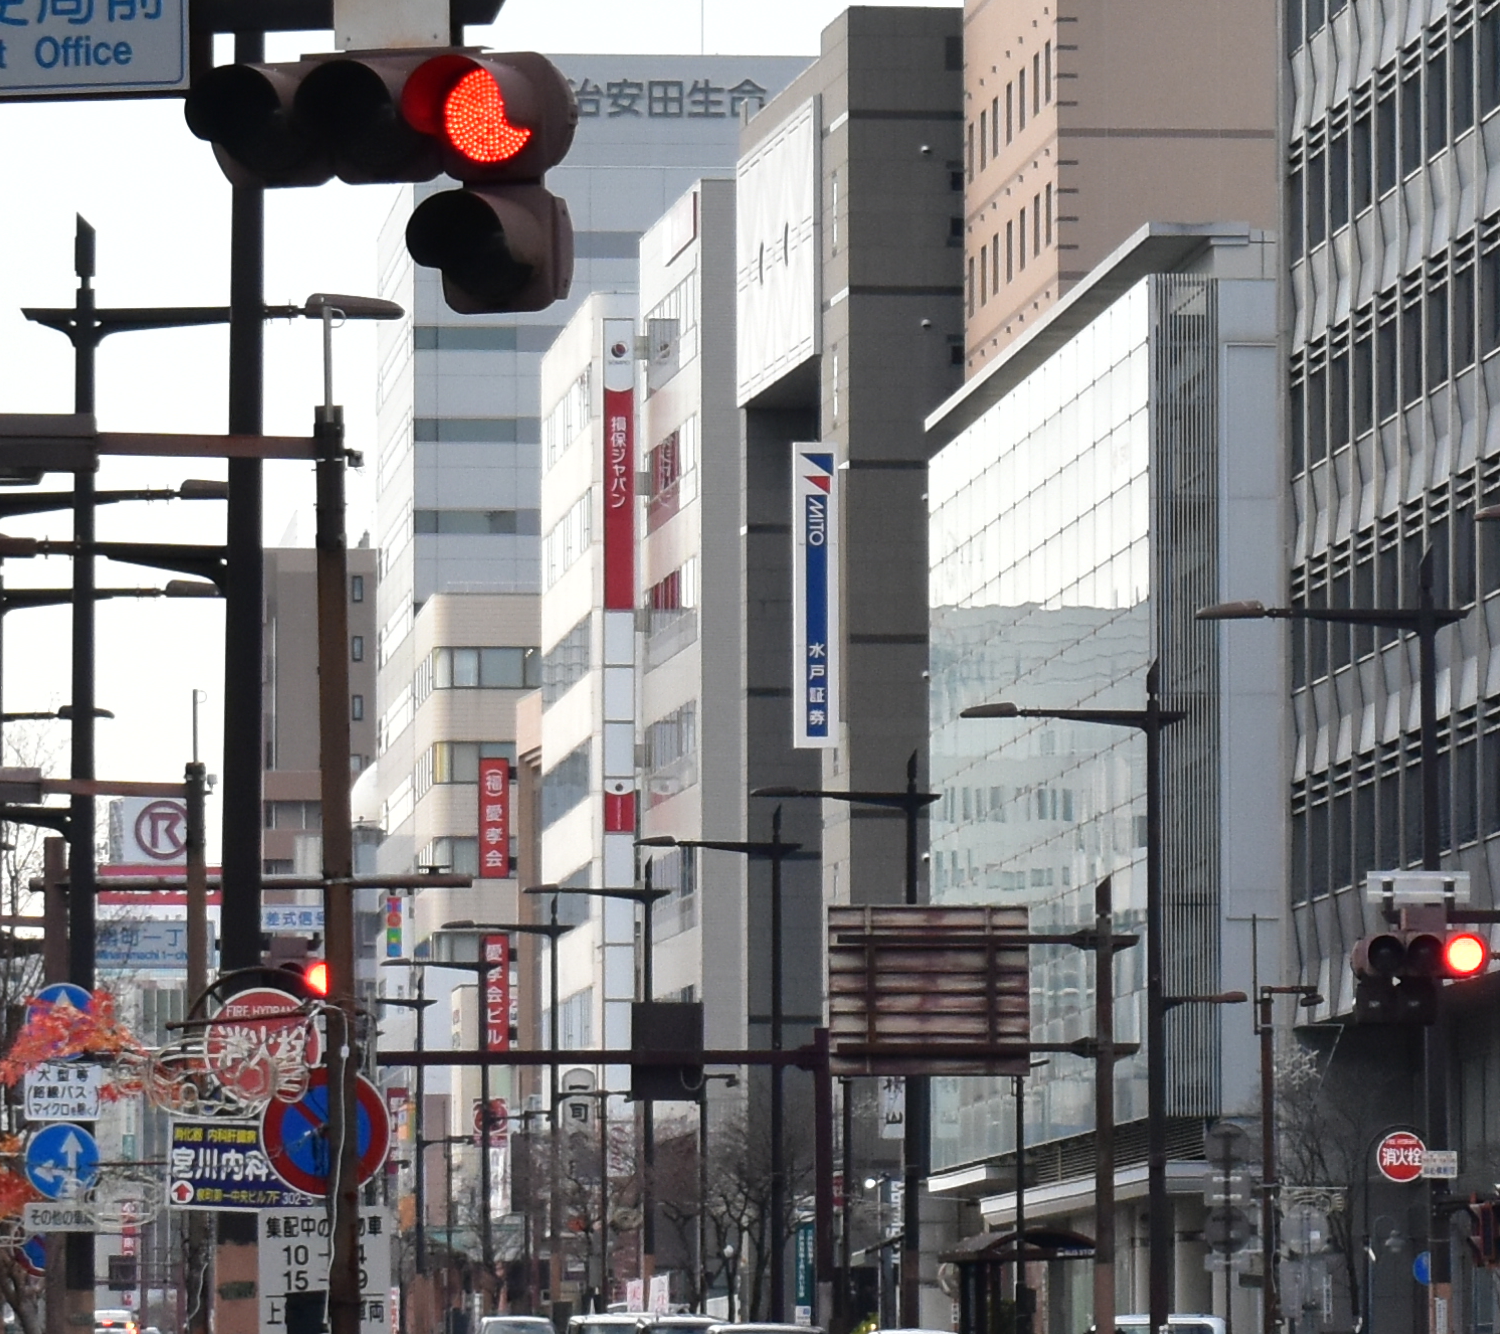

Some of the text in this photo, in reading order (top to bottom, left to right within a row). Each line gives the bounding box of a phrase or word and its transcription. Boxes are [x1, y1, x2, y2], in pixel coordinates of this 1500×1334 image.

[35, 35, 132, 69] Office
[610, 416, 627, 509] 損保ジャパン
[809, 496, 825, 546] MITO
[808, 641, 826, 728] 水戸証券
[265, 911, 325, 927] 差式信号
[172, 1146, 277, 1182] 宮川内科
[1382, 1146, 1423, 1167] 消火栓
[266, 1215, 383, 1238] 集配中の車
[282, 1244, 367, 1266] 10-4
[283, 1270, 369, 1291] 15-9
